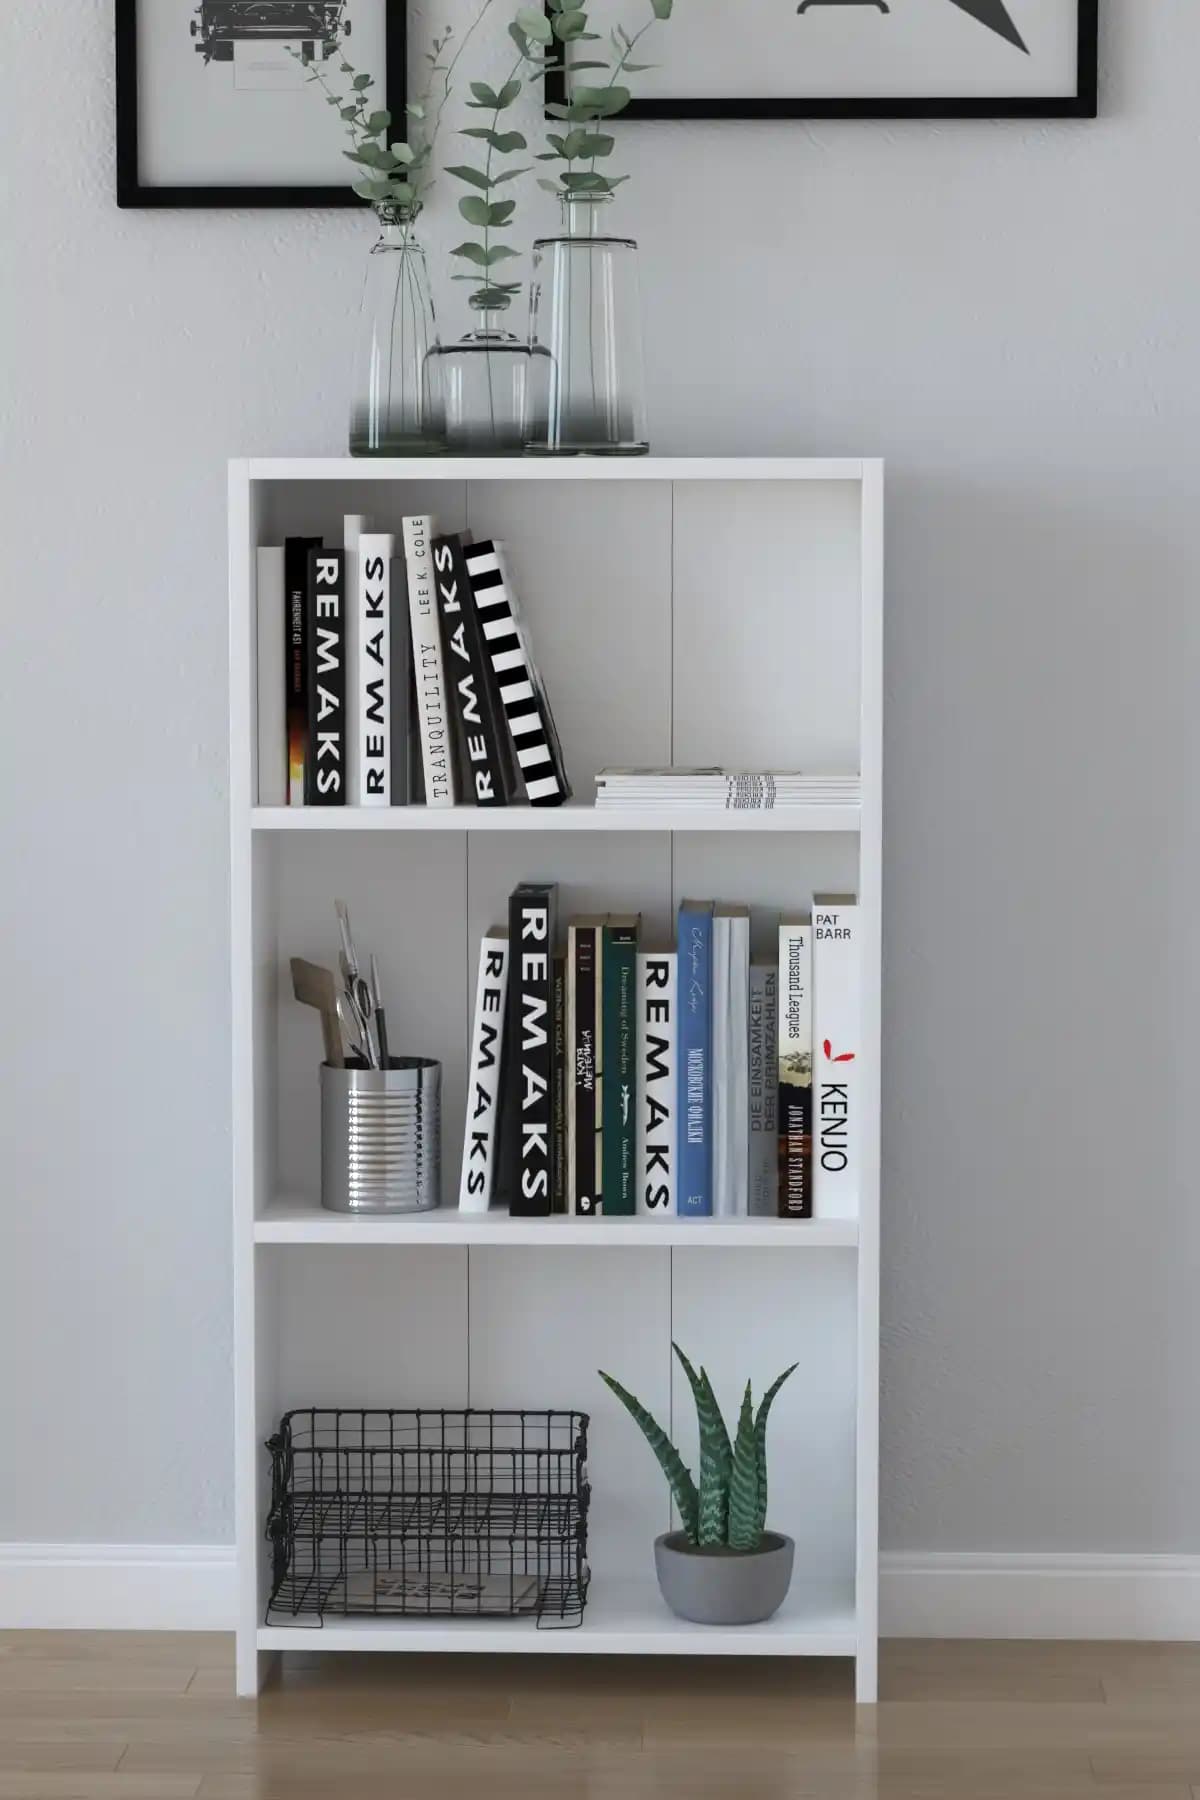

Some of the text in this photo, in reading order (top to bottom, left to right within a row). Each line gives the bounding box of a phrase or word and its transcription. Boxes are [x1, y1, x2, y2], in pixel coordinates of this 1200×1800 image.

[291, 590, 302, 632] FAHRENHEIT
[412, 519, 430, 615] LEE K. COLE
[292, 633, 302, 644] 451
[316, 558, 340, 793] REMAKS
[365, 556, 385, 794] REMAKS
[435, 544, 495, 800] REMAKS
[420, 644, 448, 798] TRANQUILITY
[816, 914, 841, 925] PAT
[816, 928, 851, 940] BARR
[785, 936, 804, 1039] Thousand Leagues
[467, 950, 504, 1196] REMAKS
[521, 907, 548, 1199] REMAKS
[576, 1047, 585, 1076] КАТЯ
[620, 1032, 630, 1074] Sweden
[646, 960, 670, 1210] REMAKS
[687, 1048, 704, 1143] МОСКОВСКИЕ ФИАЛКИ
[751, 989, 763, 1133] DIE EINSAMKEIT
[764, 972, 776, 1132] DER PRIMZAHLEN
[788, 1104, 804, 1212] JONATHAN STANDFORD
[820, 1083, 848, 1172] KENJO
